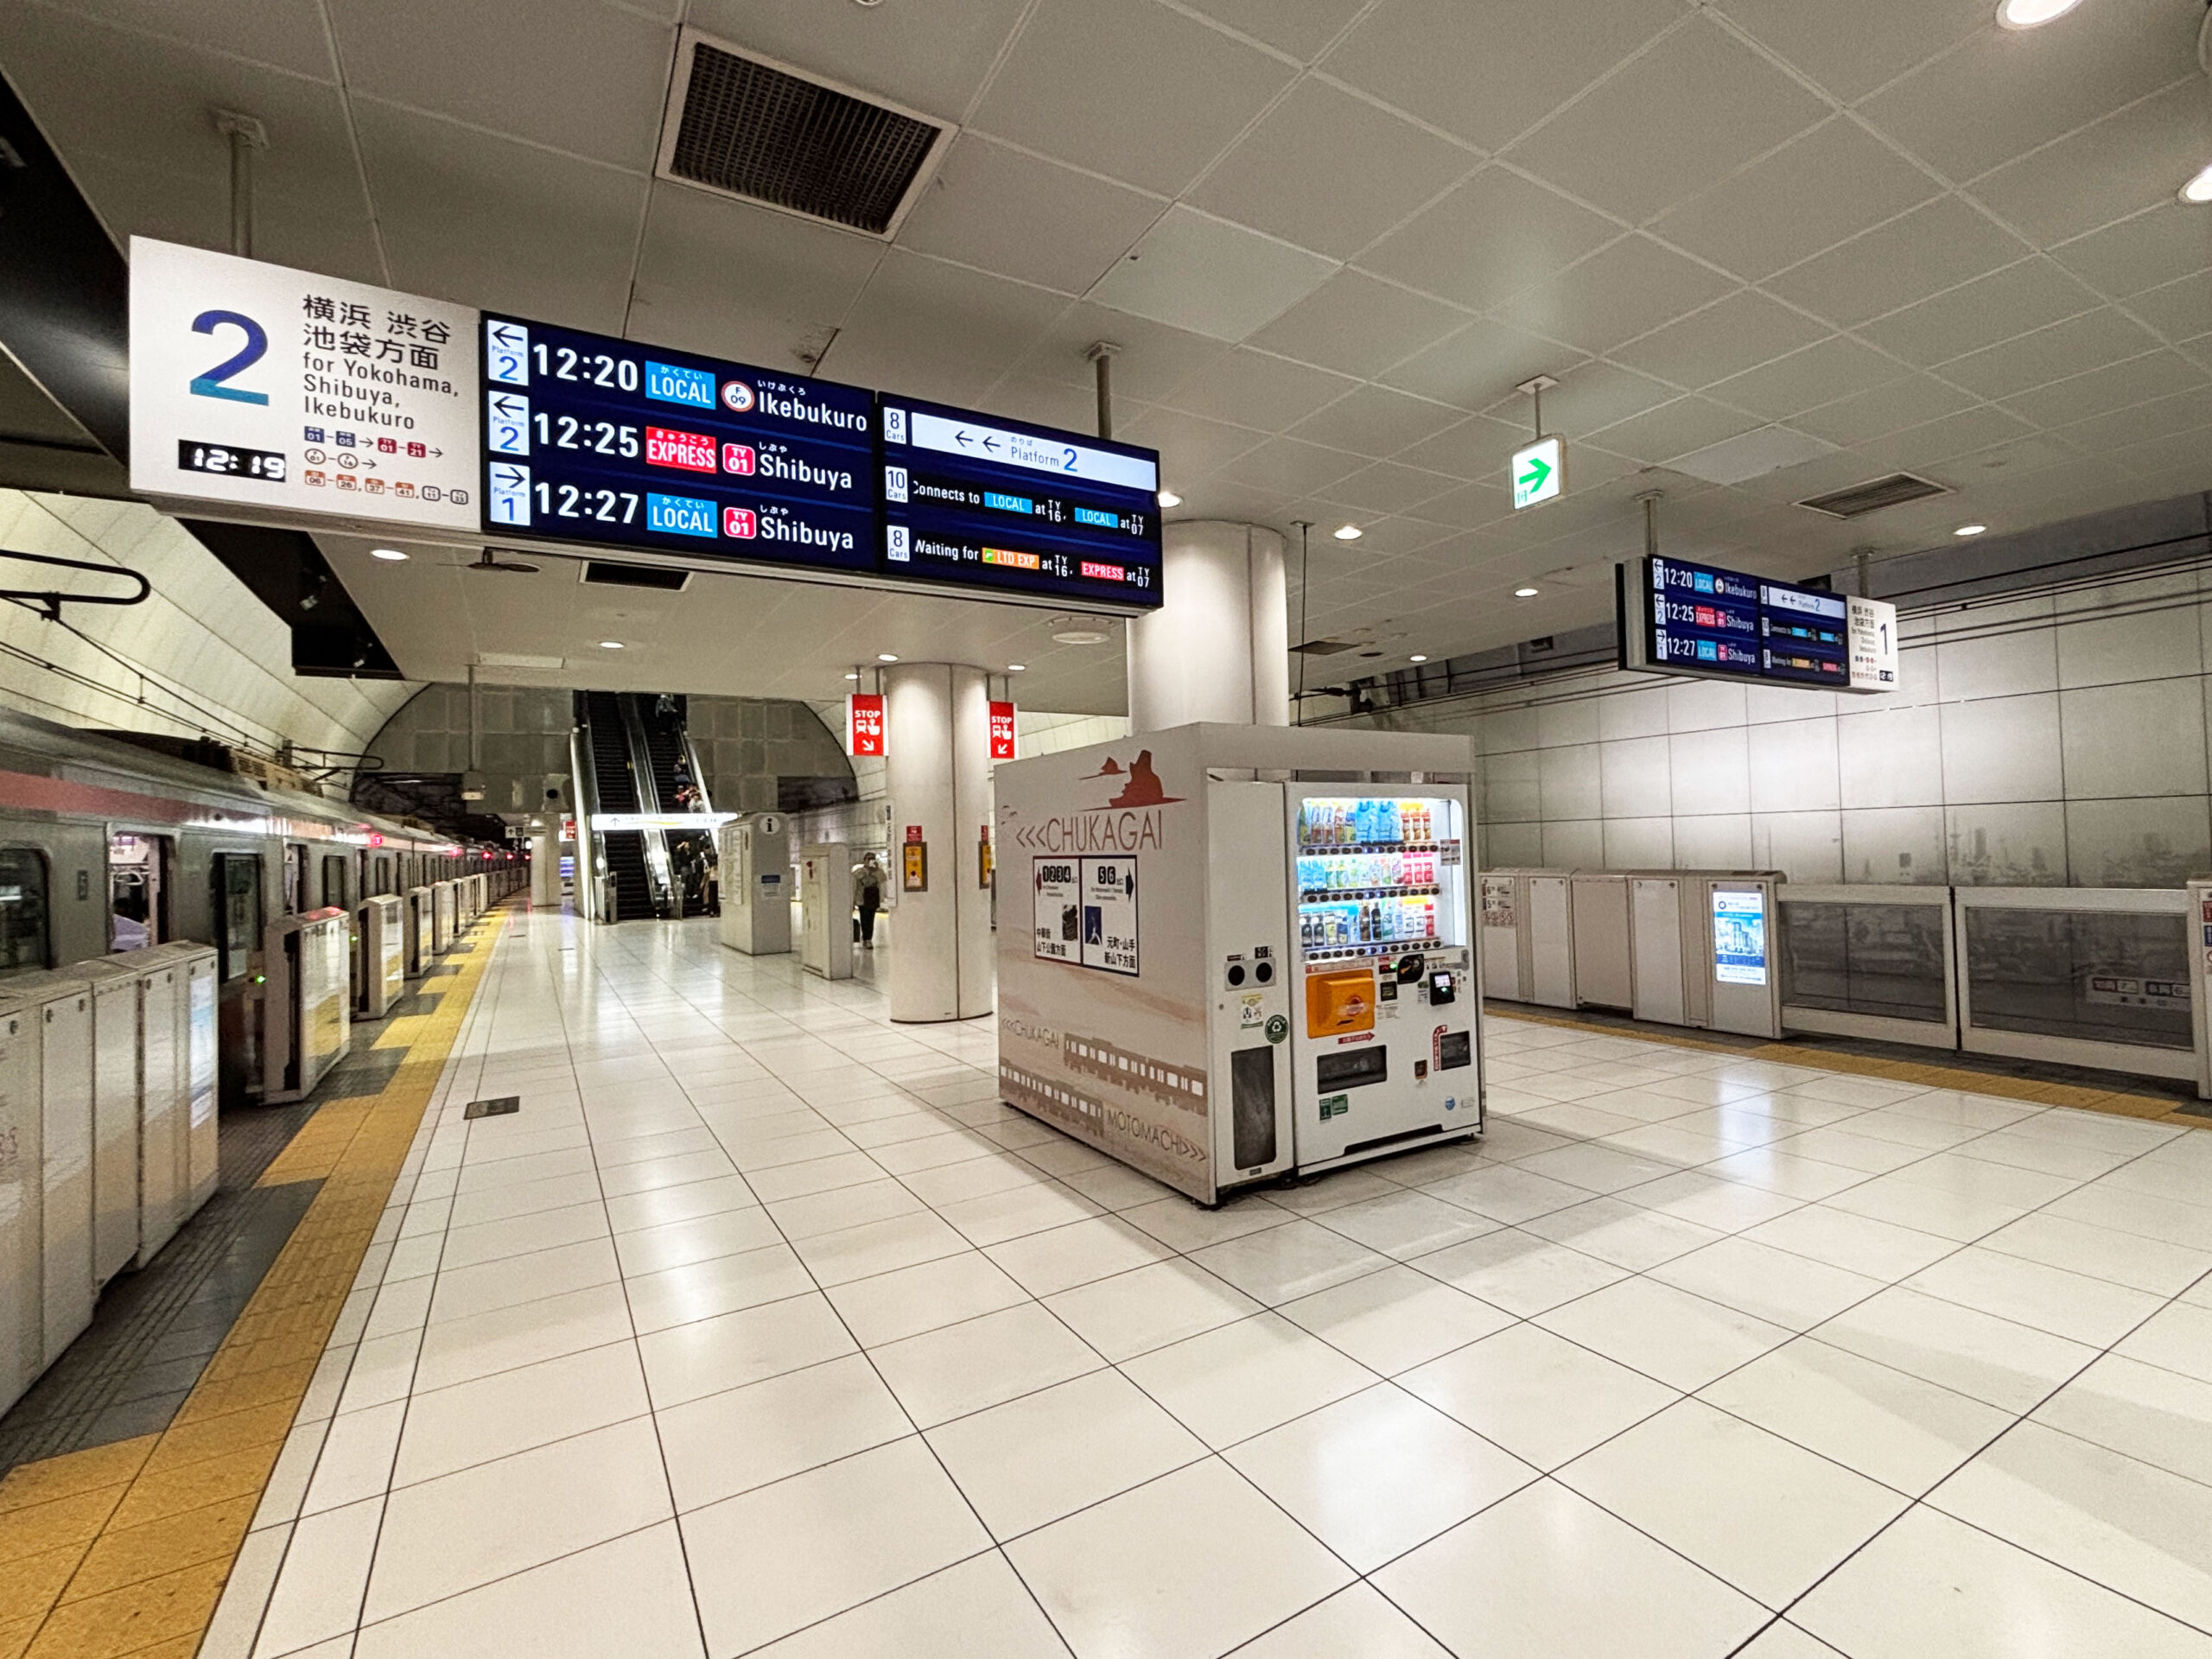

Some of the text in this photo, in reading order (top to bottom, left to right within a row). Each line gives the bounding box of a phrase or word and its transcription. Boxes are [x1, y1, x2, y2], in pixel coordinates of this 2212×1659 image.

[302, 294, 451, 345] 横浜 渋谷
[190, 309, 269, 406] 2
[303, 322, 439, 371] 池袋方面
[492, 345, 524, 358] Platform
[303, 351, 460, 397] for Yokohama,
[499, 343, 639, 391] 2 12:20
[660, 365, 702, 380] かくてい
[303, 373, 400, 409] Shibuya,
[652, 374, 712, 404] LOCAL
[757, 379, 806, 397] いけぶくろ
[730, 395, 747, 405] 09
[304, 395, 415, 430] Ikebukuro
[493, 416, 525, 429] Platform
[760, 391, 868, 432] Ikebukuro
[499, 412, 639, 458] 2 12:25
[886, 411, 906, 442] 8 Cars
[307, 433, 423, 457] 01 05 01 21
[648, 438, 716, 469] EXPRESS
[759, 441, 788, 454] しぶや
[193, 447, 287, 480] 12:19
[728, 447, 748, 472] TY 01
[1011, 446, 1078, 473] Platform 2
[760, 453, 852, 491] Shibuya
[308, 476, 410, 497] 06 26 37 41
[493, 486, 526, 499] Platform
[887, 470, 906, 500] 10 Cars
[501, 481, 639, 524] 1 12:27
[662, 497, 704, 510] かくてい
[969, 488, 980, 505] to
[993, 494, 1025, 512] LOCAL
[1048, 499, 1061, 510] TY
[653, 506, 714, 533] LOCAL
[760, 504, 789, 516] しぶや
[1035, 503, 1046, 516] at
[1082, 510, 1112, 526] LOCAL
[1132, 514, 1144, 524] TY
[729, 511, 749, 536] TY 01
[761, 516, 855, 552] Shibuya
[1120, 518, 1130, 530] at
[1131, 524, 1144, 536] 07
[889, 530, 909, 560] 8 Cars
[963, 545, 979, 562] for
[996, 551, 1015, 566] LTD
[1018, 554, 1036, 569] EXP
[1042, 558, 1052, 571] at
[1055, 555, 1068, 566] TY
[1083, 563, 1124, 580] EXPRESS
[1127, 571, 1136, 582] at
[1137, 575, 1150, 588] 07
[1138, 567, 1150, 576] TY
[1664, 567, 1694, 588] 12:20
[1694, 577, 1714, 591] LOCAL
[1725, 582, 1758, 601] Ikebukuro
[1666, 601, 1694, 623] 12:25
[1695, 611, 1716, 626] EXPRESS
[1726, 615, 1755, 632] Shibuya
[1880, 623, 1888, 655] 1
[1668, 637, 1696, 657] 12:27
[1697, 647, 1717, 660] LOCAL
[1728, 648, 1756, 665] Shibuya
[855, 709, 881, 719] STOP
[991, 715, 1013, 724] STOP
[1046, 810, 1163, 852] CHUKAGAI
[1107, 1109, 1184, 1155] MOTOMACHI
